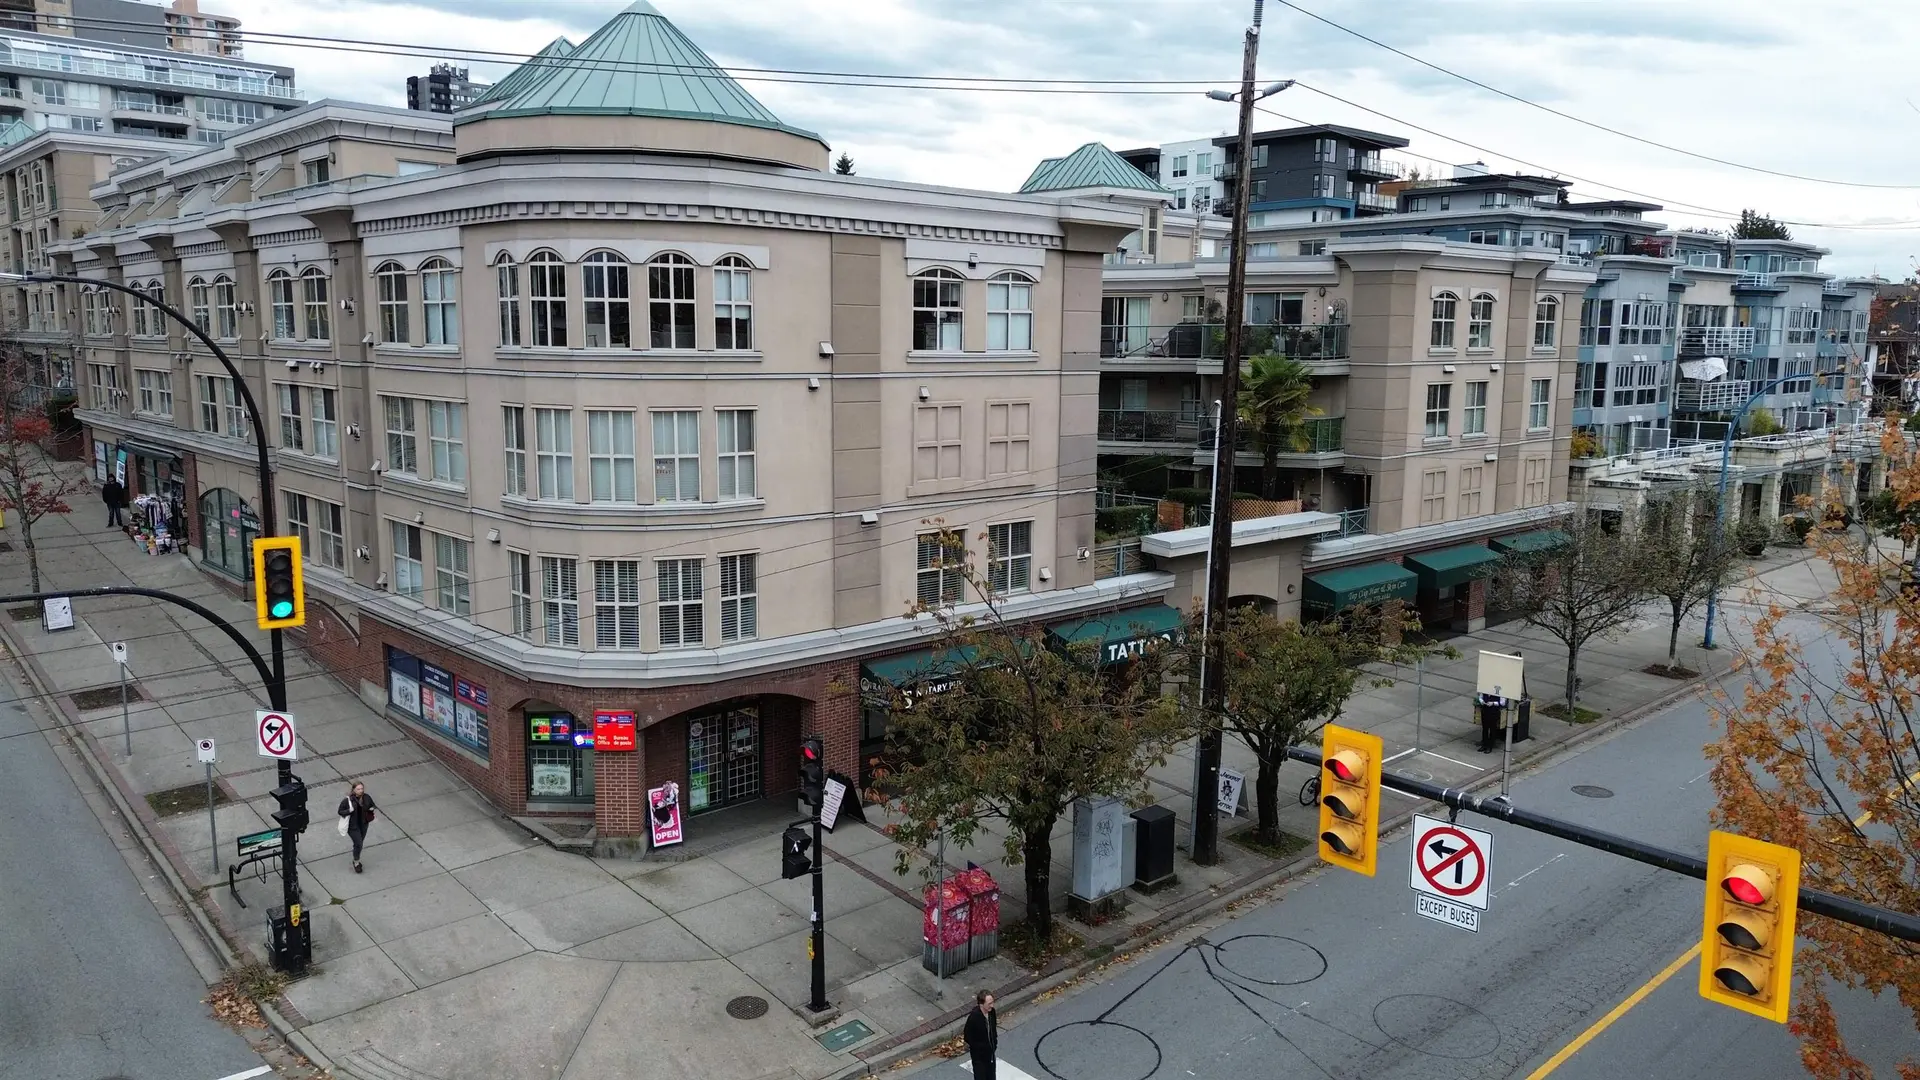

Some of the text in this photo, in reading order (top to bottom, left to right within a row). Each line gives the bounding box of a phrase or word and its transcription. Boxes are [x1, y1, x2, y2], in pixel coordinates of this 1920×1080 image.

[656, 830, 678, 840] OPEN
[1420, 899, 1475, 926] EXCEPT BUSES
